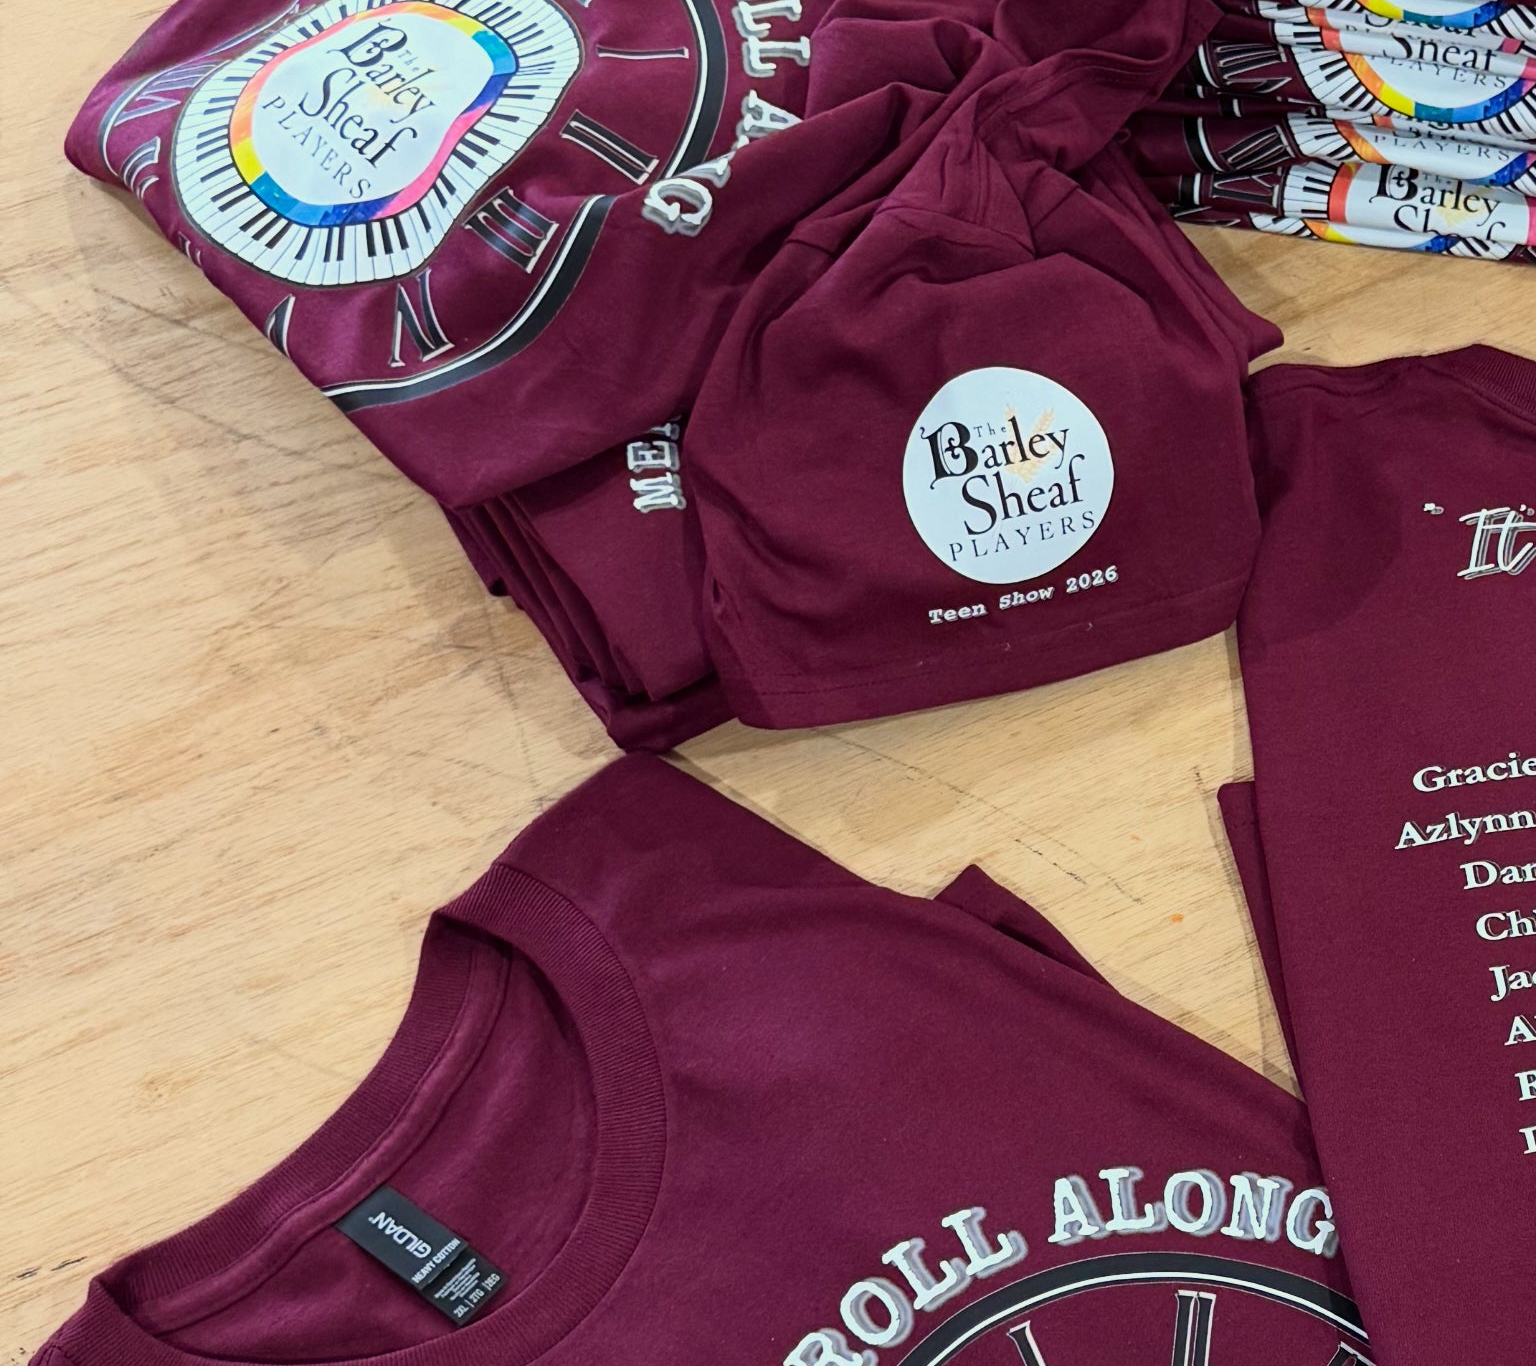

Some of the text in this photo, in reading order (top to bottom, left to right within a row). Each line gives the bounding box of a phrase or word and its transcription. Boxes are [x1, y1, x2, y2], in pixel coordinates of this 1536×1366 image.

[326, 18, 437, 125] Barley
[262, 95, 371, 199] PLAYERS
[298, 67, 418, 169] Sheaf
[1374, 132, 1512, 164] PLAYERS
[1368, 163, 1503, 227] Barley
[920, 415, 1070, 490] Barley
[973, 422, 1008, 438] The
[961, 453, 1086, 536] Sheaf
[949, 510, 1096, 562] PLAYERS
[928, 565, 1119, 625] Teen Show 2026
[1047, 1166, 1337, 1258] ALONG
[411, 1260, 436, 1284] HEAVY
[432, 1237, 461, 1264] COTTON
